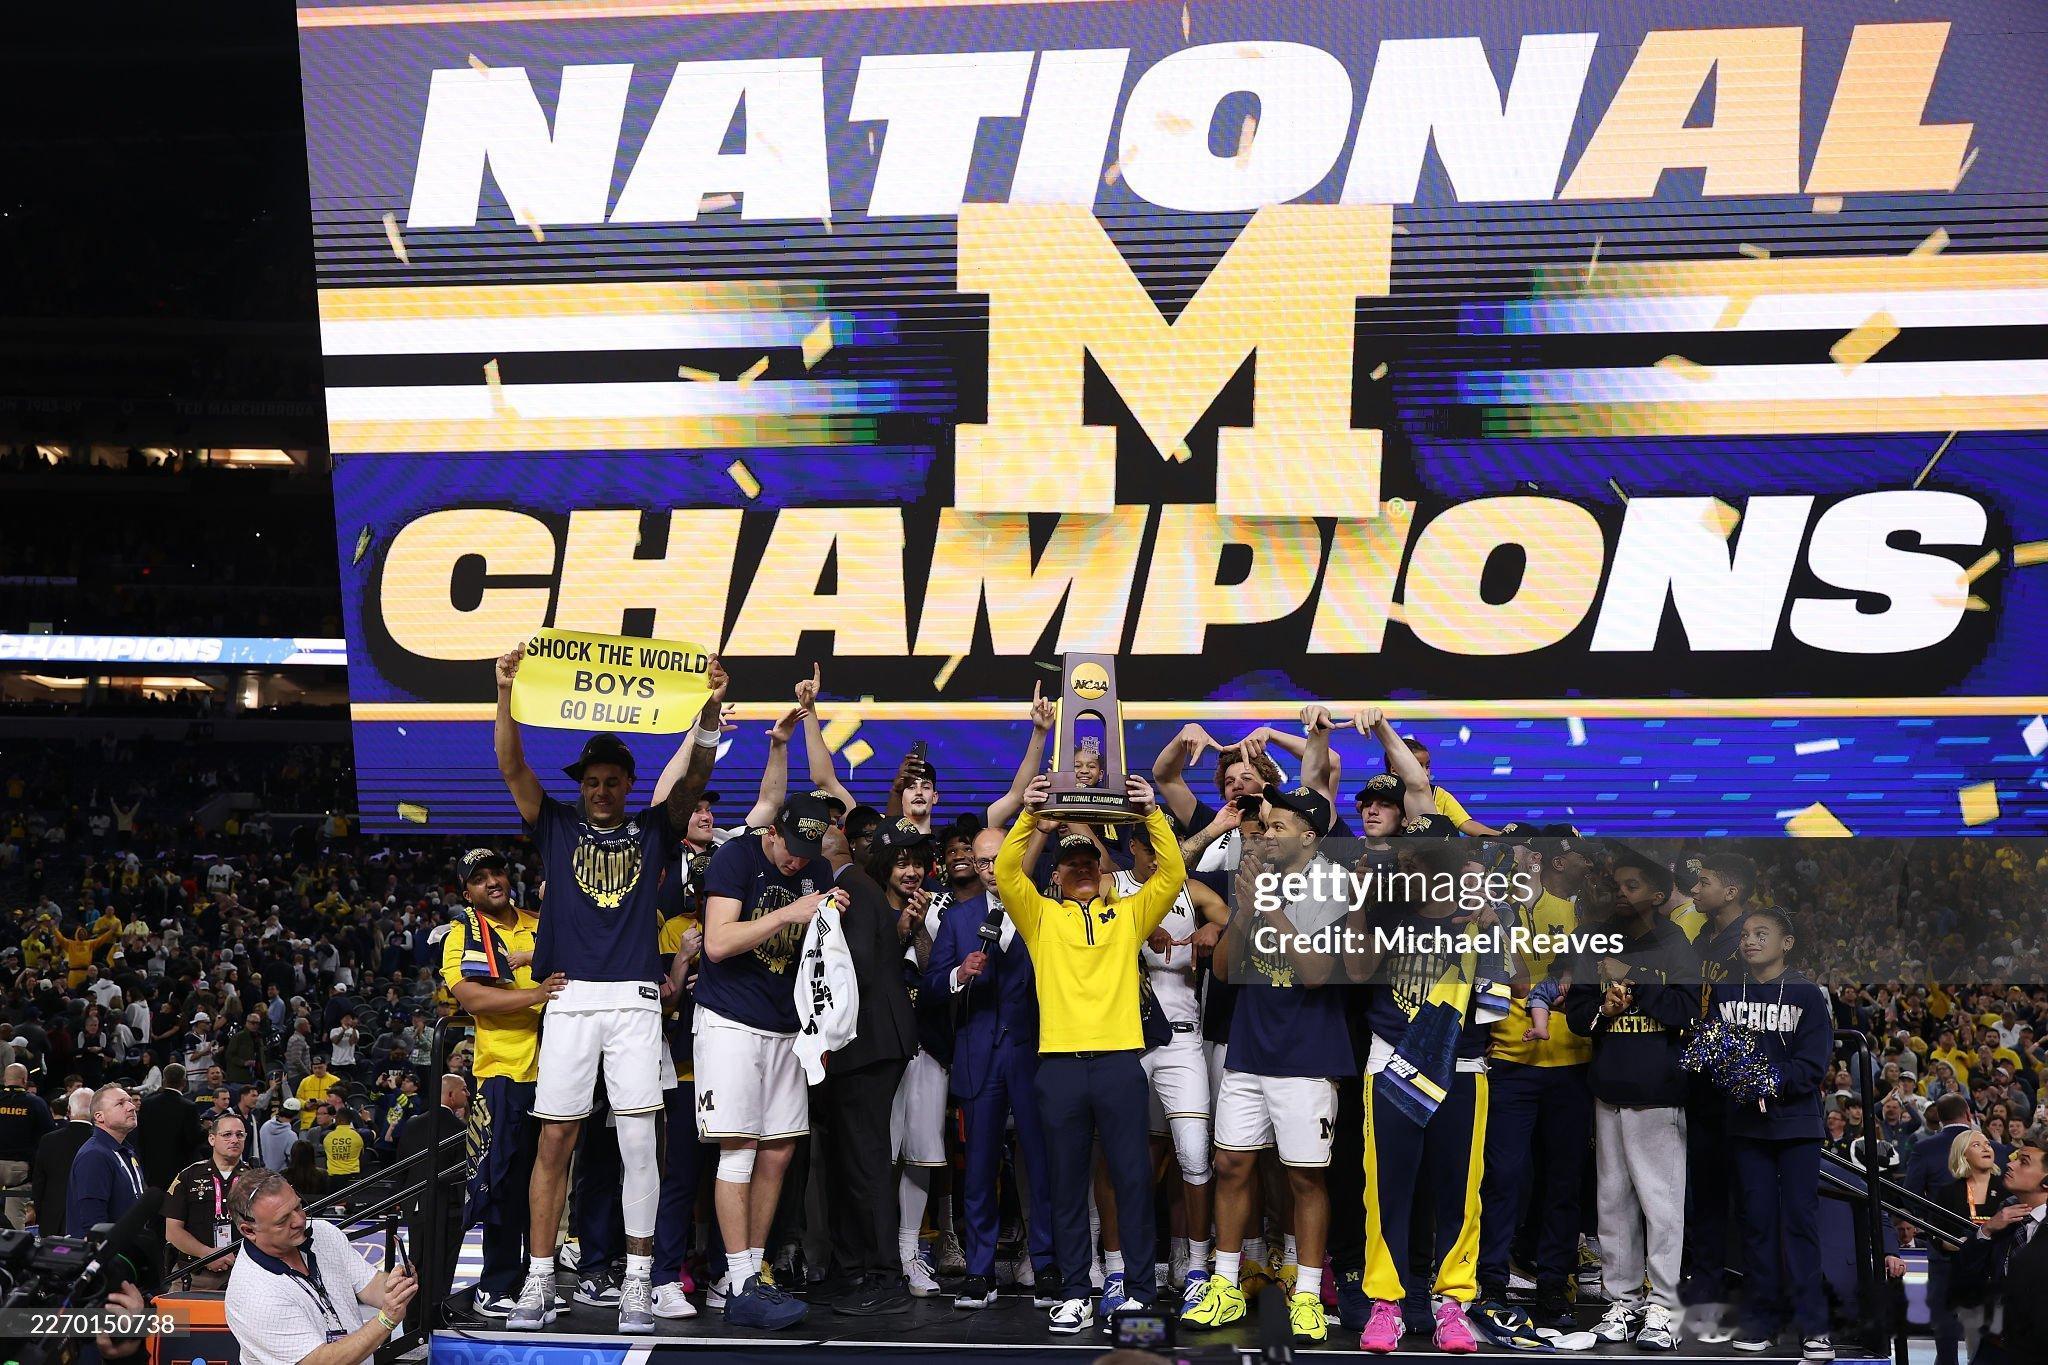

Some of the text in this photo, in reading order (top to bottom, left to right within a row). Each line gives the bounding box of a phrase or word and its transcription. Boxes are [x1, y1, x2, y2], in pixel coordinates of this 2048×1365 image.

[407, 22, 1974, 228] NATIONAL
[954, 203, 1393, 518] M
[380, 490, 1987, 660] CHAMPIONS
[0, 634, 223, 662] CHAMPIONS
[526, 636, 708, 674] SHOCK THE WORLD
[574, 670, 655, 699] BOYS
[1074, 679, 1109, 692] NCAA
[560, 699, 659, 726] GO BLUE !
[1062, 794, 1124, 805] NATIONAL CHAMPION
[597, 893, 620, 908] M
[1098, 908, 1116, 924] M
[1271, 970, 1293, 988] M
[1718, 1001, 1803, 1033] MICHIGAN
[0, 1107, 28, 1116] OLICE
[698, 1090, 715, 1112] M
[332, 1137, 352, 1145] CSC
[1346, 1271, 1359, 1282] M
